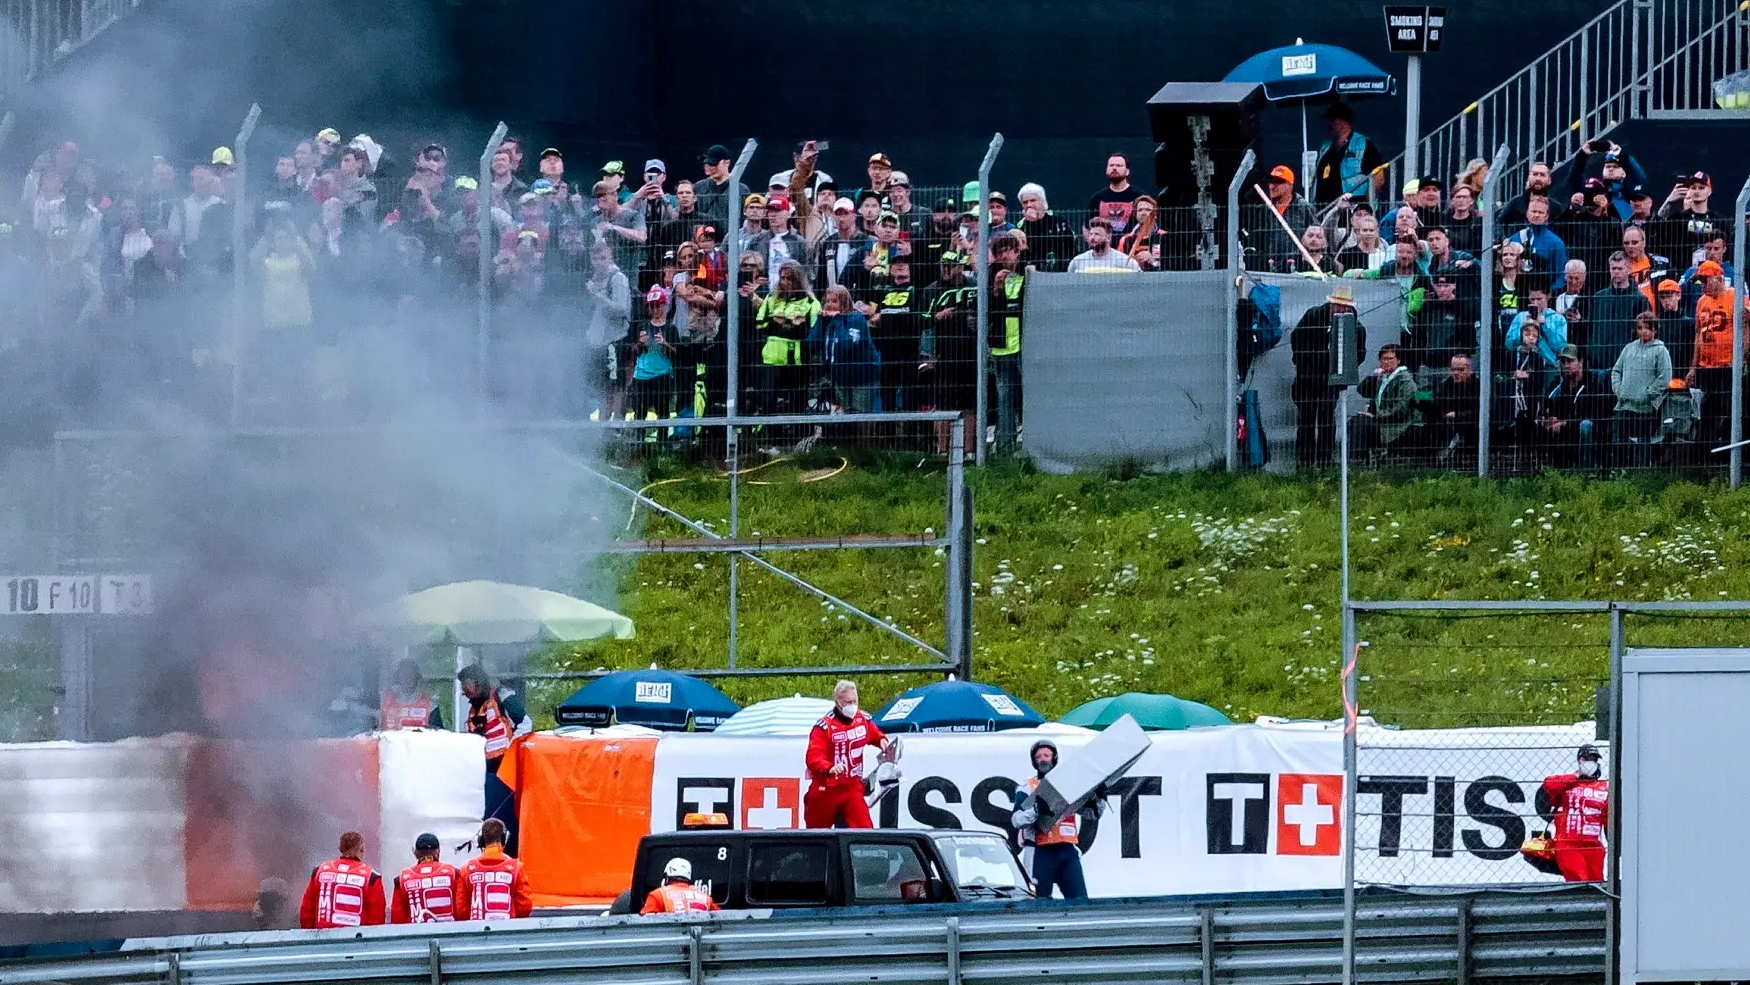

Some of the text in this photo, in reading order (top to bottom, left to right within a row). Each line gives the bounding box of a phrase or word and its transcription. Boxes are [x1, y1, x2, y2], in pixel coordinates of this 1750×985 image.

[1390, 15, 1422, 27] SMOKING
[1397, 29, 1416, 40] AREA
[7, 578, 38, 612] 10
[717, 847, 727, 860] 8
